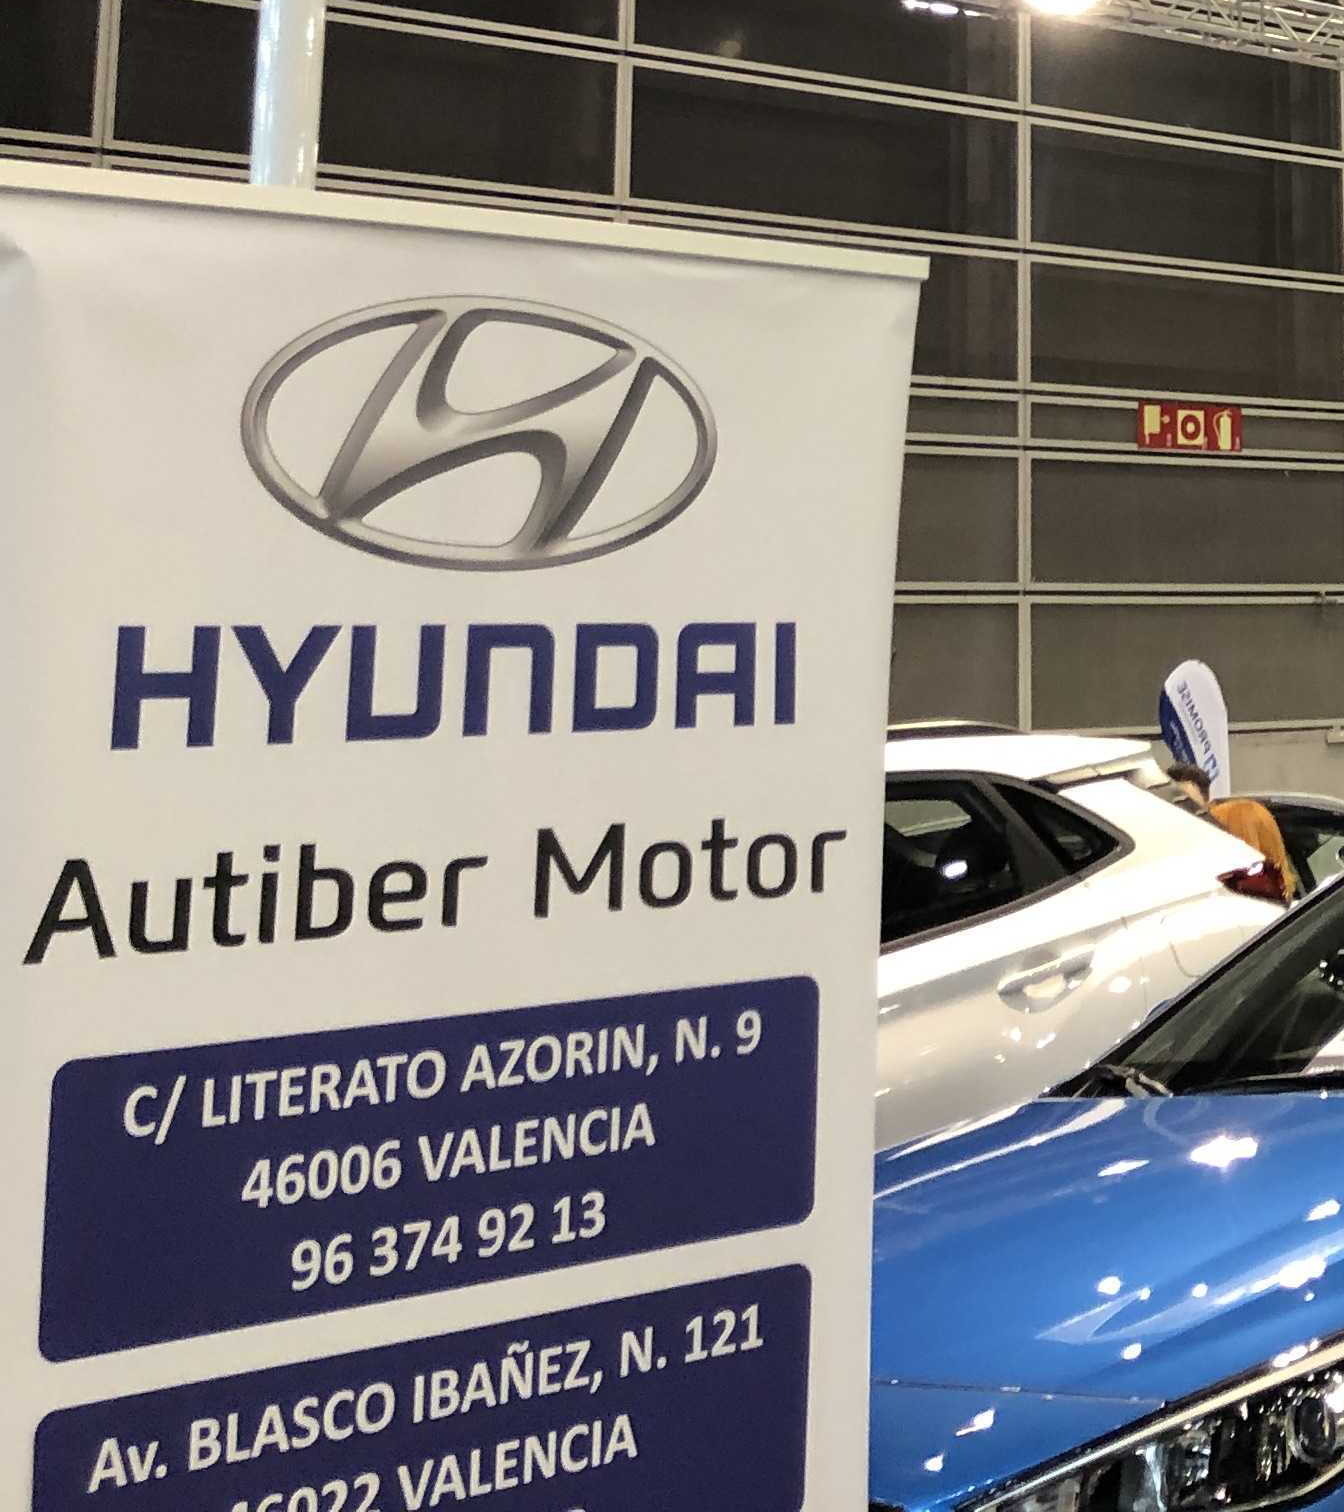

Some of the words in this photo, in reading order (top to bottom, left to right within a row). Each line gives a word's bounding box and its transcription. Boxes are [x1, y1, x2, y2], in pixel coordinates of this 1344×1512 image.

[109, 621, 797, 751] HYUNDAI
[22, 842, 489, 966] Autiber
[534, 818, 848, 920] Motor
[122, 1076, 187, 1145] C/
[200, 1049, 447, 1131] LITERATO
[460, 1023, 660, 1096] AZORIN,
[674, 1017, 723, 1062] N.
[735, 1009, 764, 1058] 9
[241, 1138, 403, 1211] 46006
[417, 1102, 657, 1184] VALENCIA
[290, 1234, 354, 1292] 96
[369, 1213, 464, 1279] 374
[477, 1203, 536, 1259] 92
[551, 1190, 608, 1246] 13
[88, 1438, 169, 1494] Av.
[187, 1381, 396, 1474] BLASCO
[412, 1338, 604, 1425] IBAÑEZ,
[619, 1328, 671, 1378] N.
[683, 1304, 765, 1367] 121
[397, 1414, 638, 1511] VALENCIA
